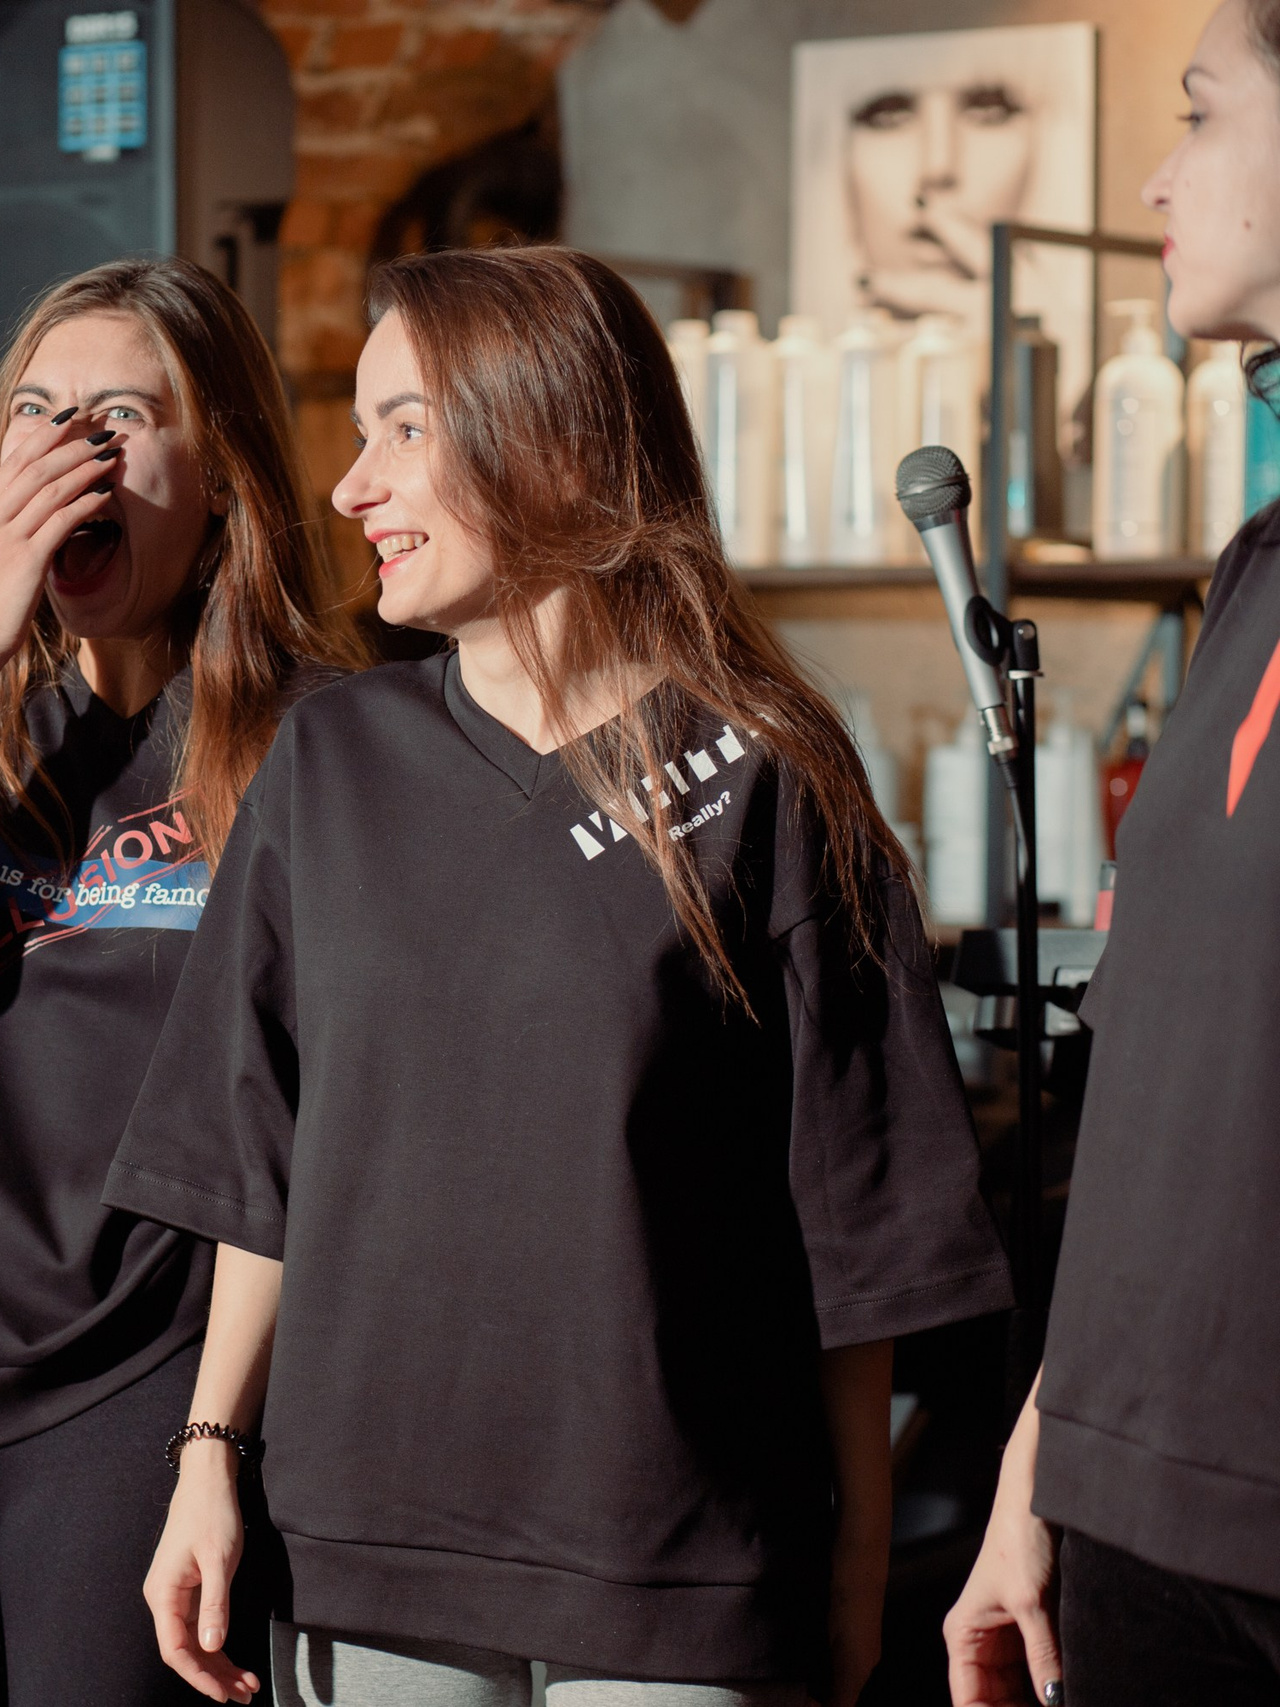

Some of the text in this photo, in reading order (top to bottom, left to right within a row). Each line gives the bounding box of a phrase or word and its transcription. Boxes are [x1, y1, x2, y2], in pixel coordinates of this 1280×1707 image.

[668, 791, 731, 842] Really?
[26, 877, 72, 904] for
[74, 882, 140, 909] being
[141, 883, 210, 907] famo
